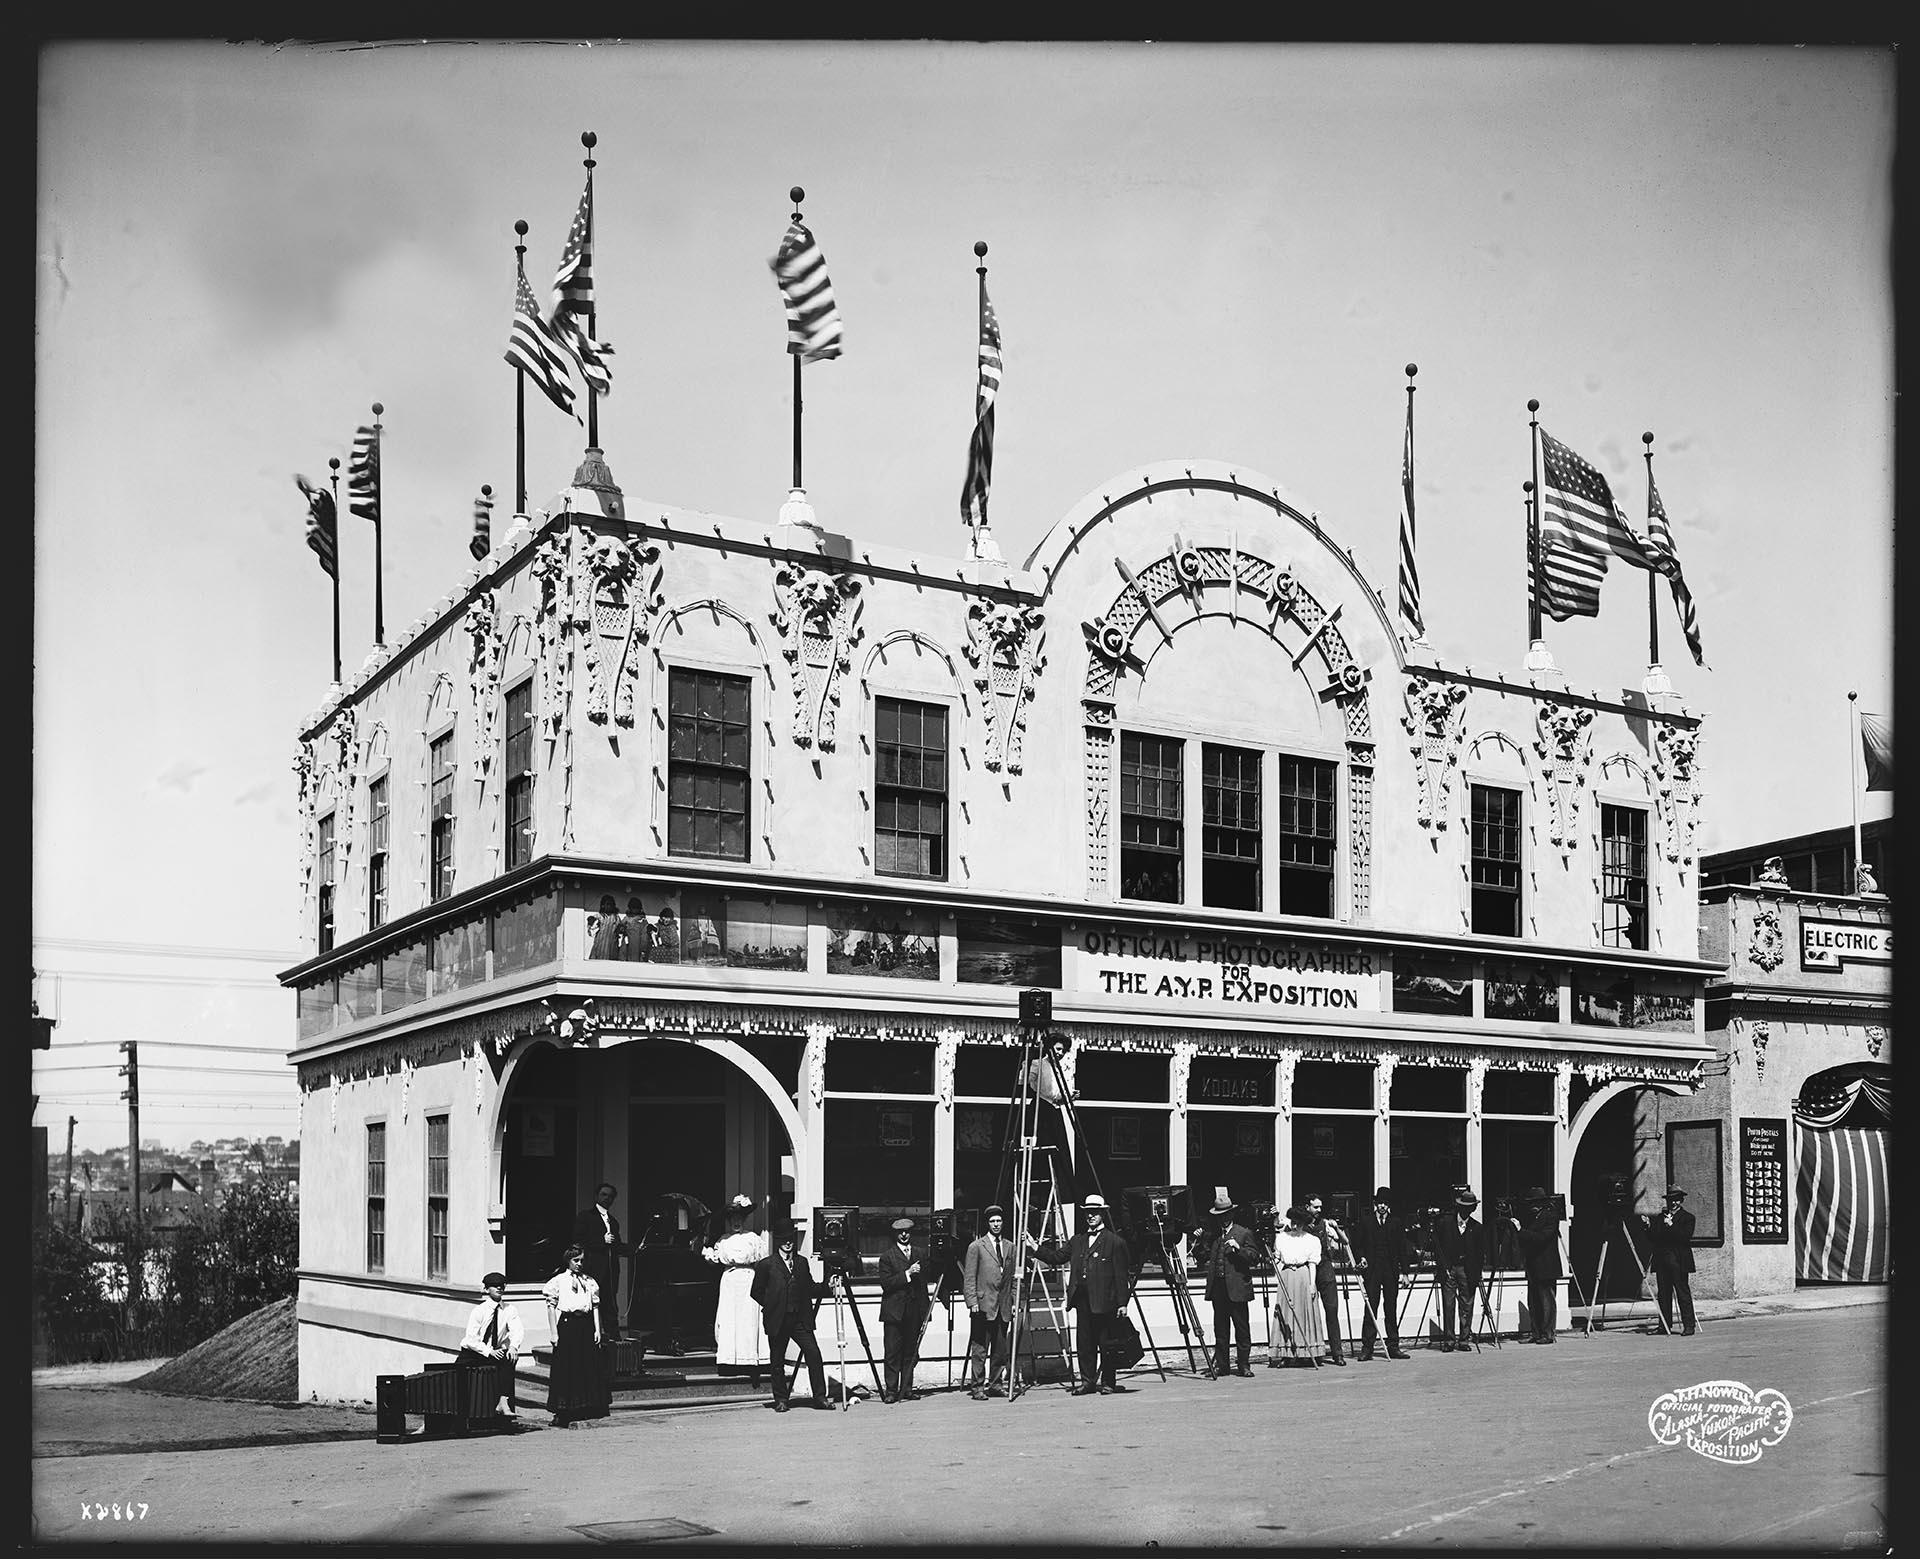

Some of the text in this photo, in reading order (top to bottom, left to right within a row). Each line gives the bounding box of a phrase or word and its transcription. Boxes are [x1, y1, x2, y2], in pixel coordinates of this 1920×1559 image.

[1805, 930, 1878, 950] ELECTRIC
[1085, 932, 1373, 977] OFFICIAL PHOTOGRAPHER
[1221, 965, 1251, 982] FOR
[1099, 970, 1358, 1009] THE A.Y.P. EXPOSITION
[1200, 1077, 1258, 1098] KODAKS
